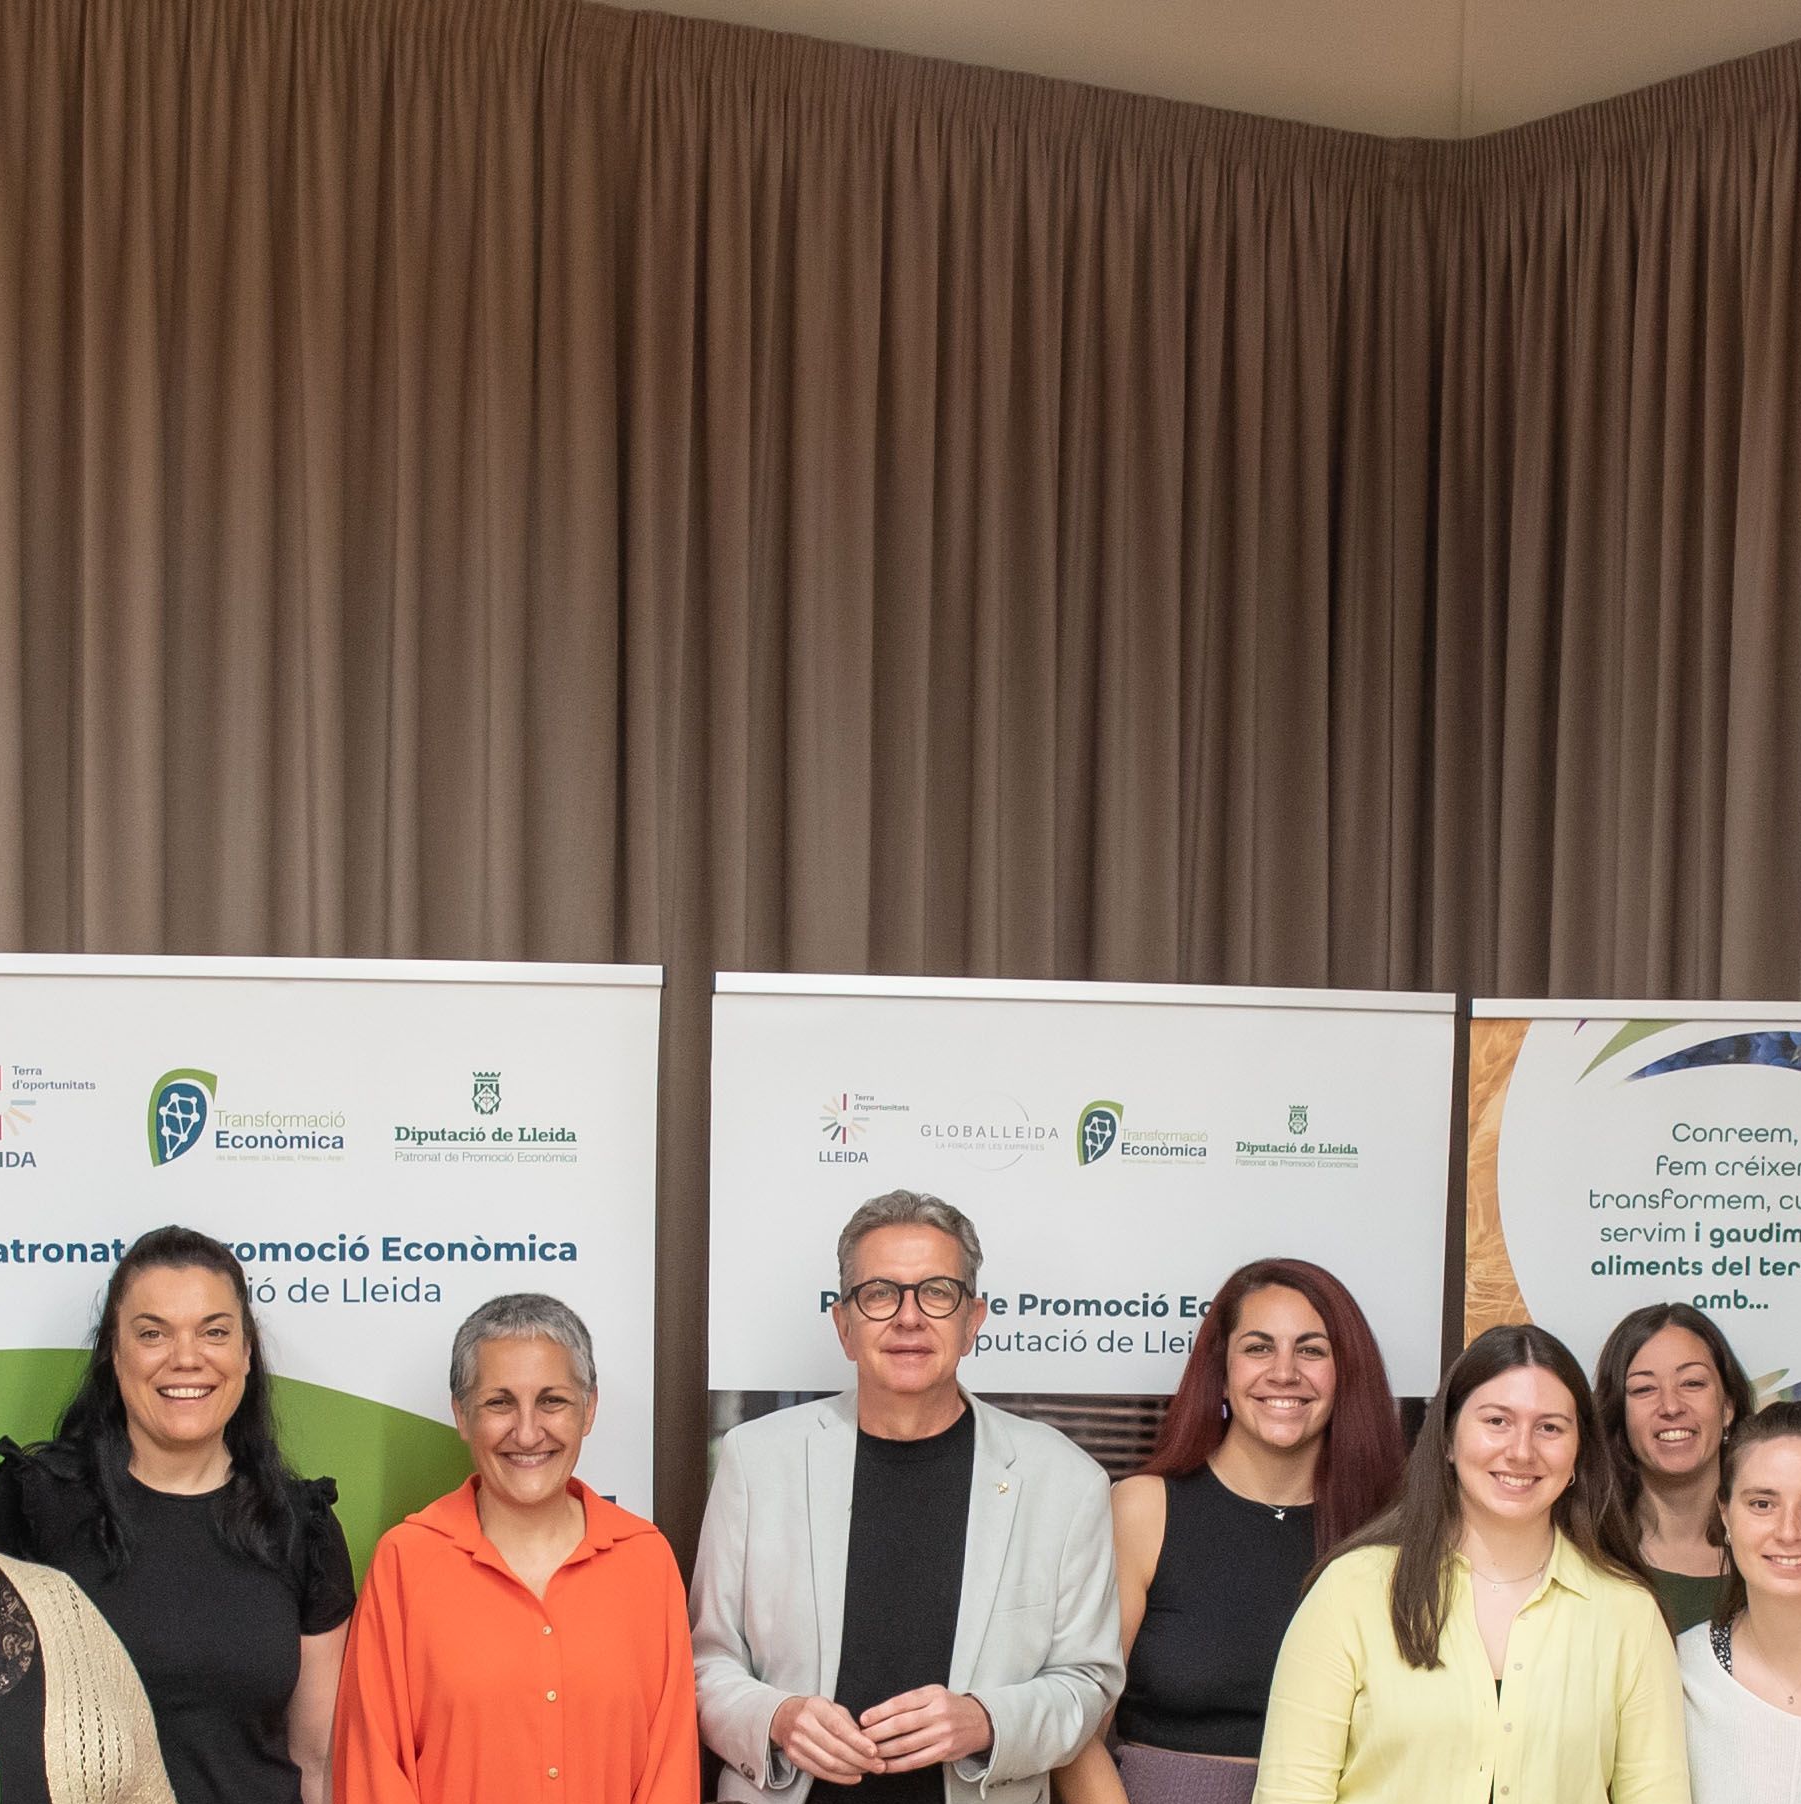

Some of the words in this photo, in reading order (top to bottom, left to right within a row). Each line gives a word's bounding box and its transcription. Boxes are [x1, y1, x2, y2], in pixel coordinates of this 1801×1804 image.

[12, 1065, 42, 1076] Terra
[12, 1080, 96, 1091] d'oportunitats
[214, 1110, 346, 1128] Transformació
[216, 1129, 344, 1149] Econòmica
[394, 1126, 486, 1145] Diputació
[491, 1127, 513, 1142] de
[518, 1127, 577, 1142] Lleida
[920, 1124, 1059, 1139] GLOBALLEIDA
[1122, 1128, 1208, 1142] Transformació
[1672, 1122, 1799, 1146] Conreem,
[394, 1151, 441, 1162] Patronat
[444, 1152, 459, 1162] de
[462, 1151, 514, 1162] Promoció
[518, 1152, 577, 1163] Econòmica
[819, 1151, 869, 1163] LLEIDA
[1121, 1142, 1207, 1157] Econòmica
[1236, 1141, 1297, 1154] Diputació
[1301, 1143, 1315, 1154] de
[1318, 1143, 1358, 1155] Lleida
[1268, 1159, 1278, 1167] de
[1656, 1155, 1706, 1176] fem
[1589, 1188, 1771, 1213] transformem,
[1599, 1222, 1686, 1243] servim
[1694, 1222, 1701, 1243] i
[221, 1233, 369, 1262] omoció
[382, 1234, 578, 1262] Econòmica
[1590, 1254, 1702, 1278] aliments
[1711, 1254, 1751, 1277] del
[288, 1278, 330, 1303] de
[342, 1278, 441, 1303] Lleida
[1693, 1289, 1769, 1310] amb...
[1018, 1293, 1168, 1318] Promoció
[975, 1329, 1087, 1357] putació
[1097, 1329, 1134, 1353] de
[1145, 1330, 1192, 1354] Llei
